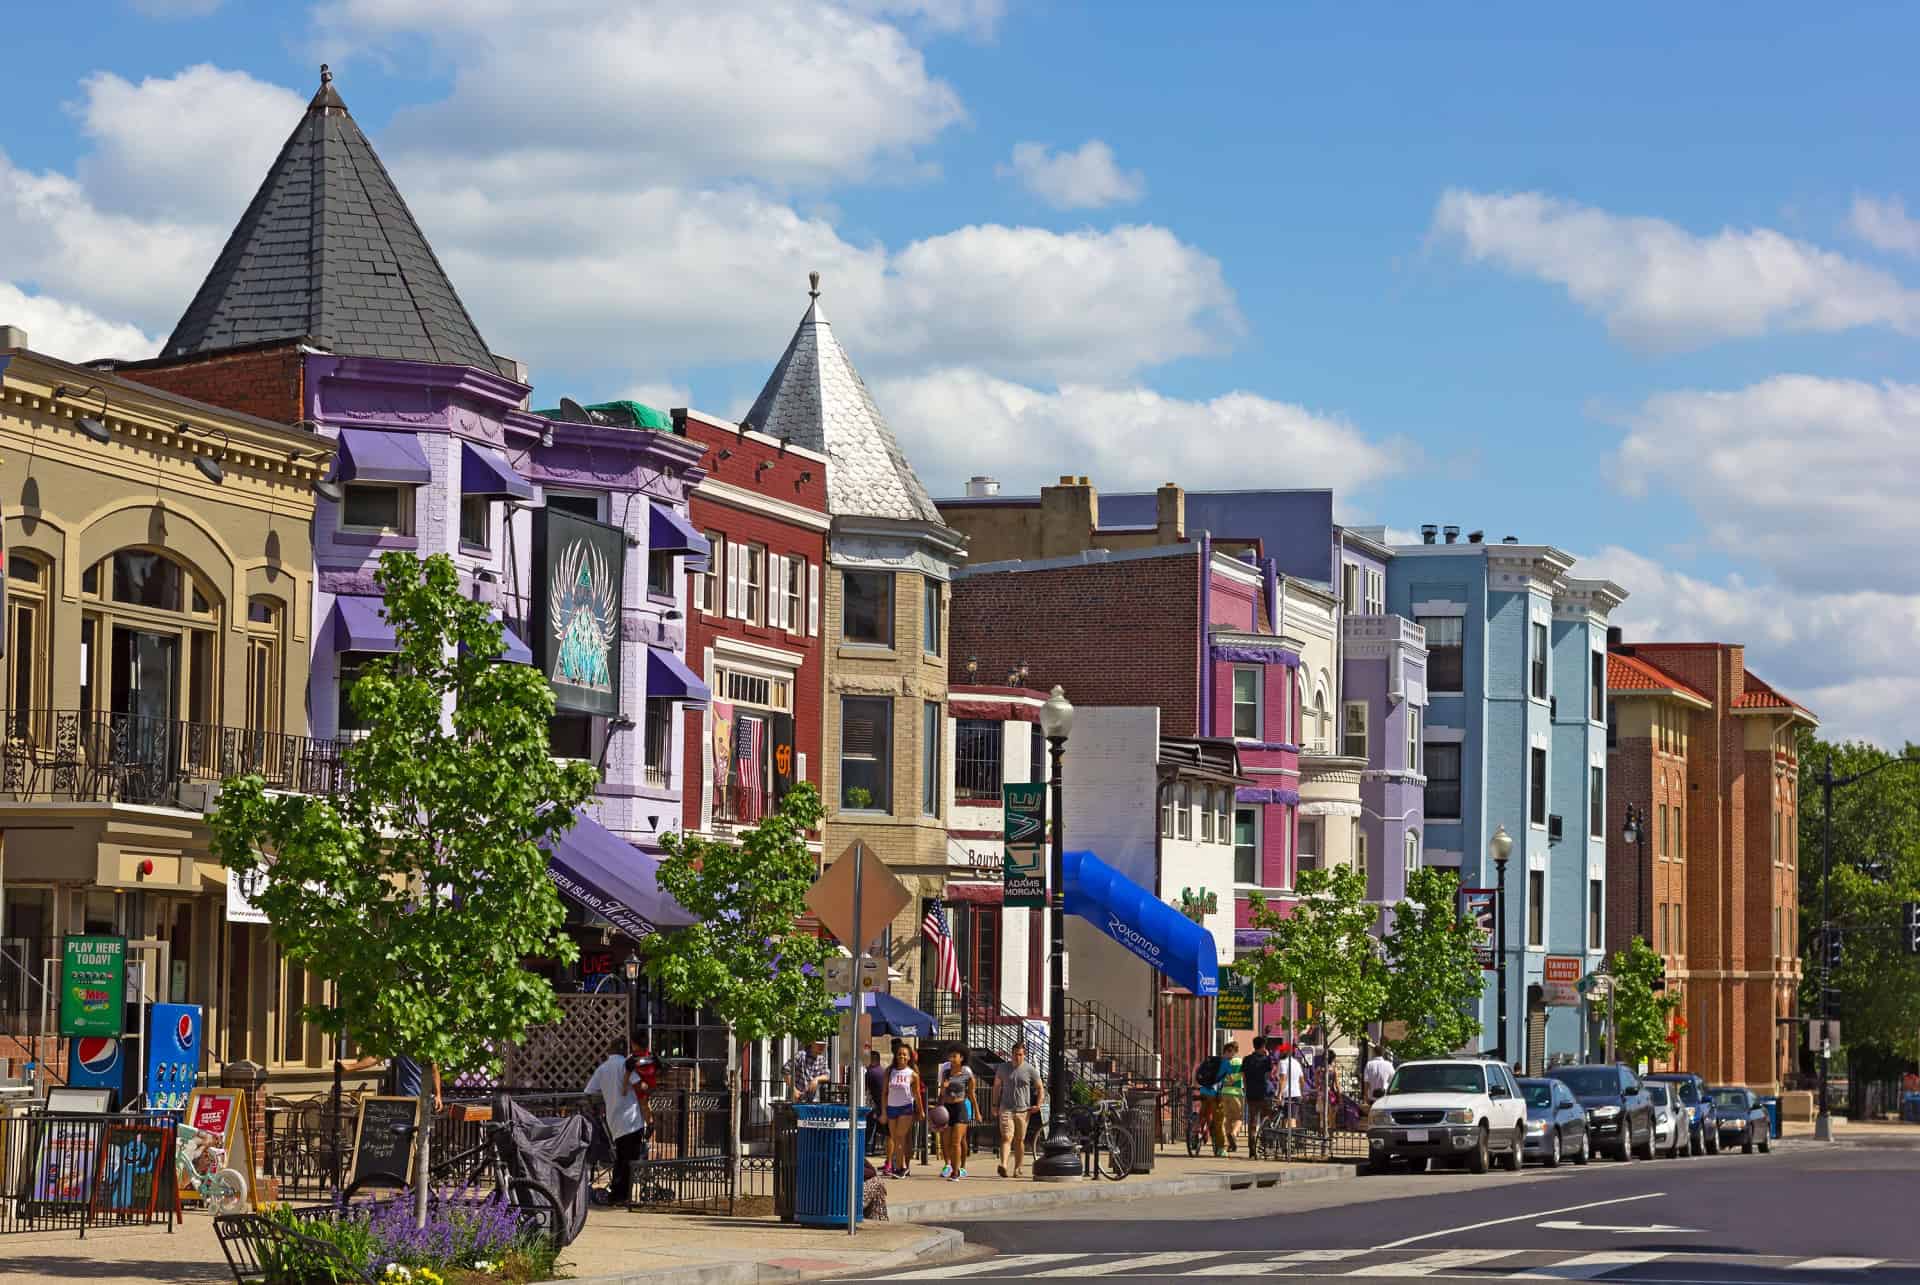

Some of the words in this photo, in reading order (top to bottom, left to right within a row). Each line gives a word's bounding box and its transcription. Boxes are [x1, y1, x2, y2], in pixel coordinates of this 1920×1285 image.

[1006, 792, 1043, 877] LIVE
[545, 868, 572, 891] GREEN
[570, 886, 601, 908] ISLAND
[1008, 880, 1040, 888] ADAMS
[1005, 888, 1044, 896] MORGAN
[1108, 912, 1160, 956] Roxanne
[68, 942, 93, 953] PLAY
[96, 942, 121, 954] HERE
[76, 954, 112, 965] TODAY!
